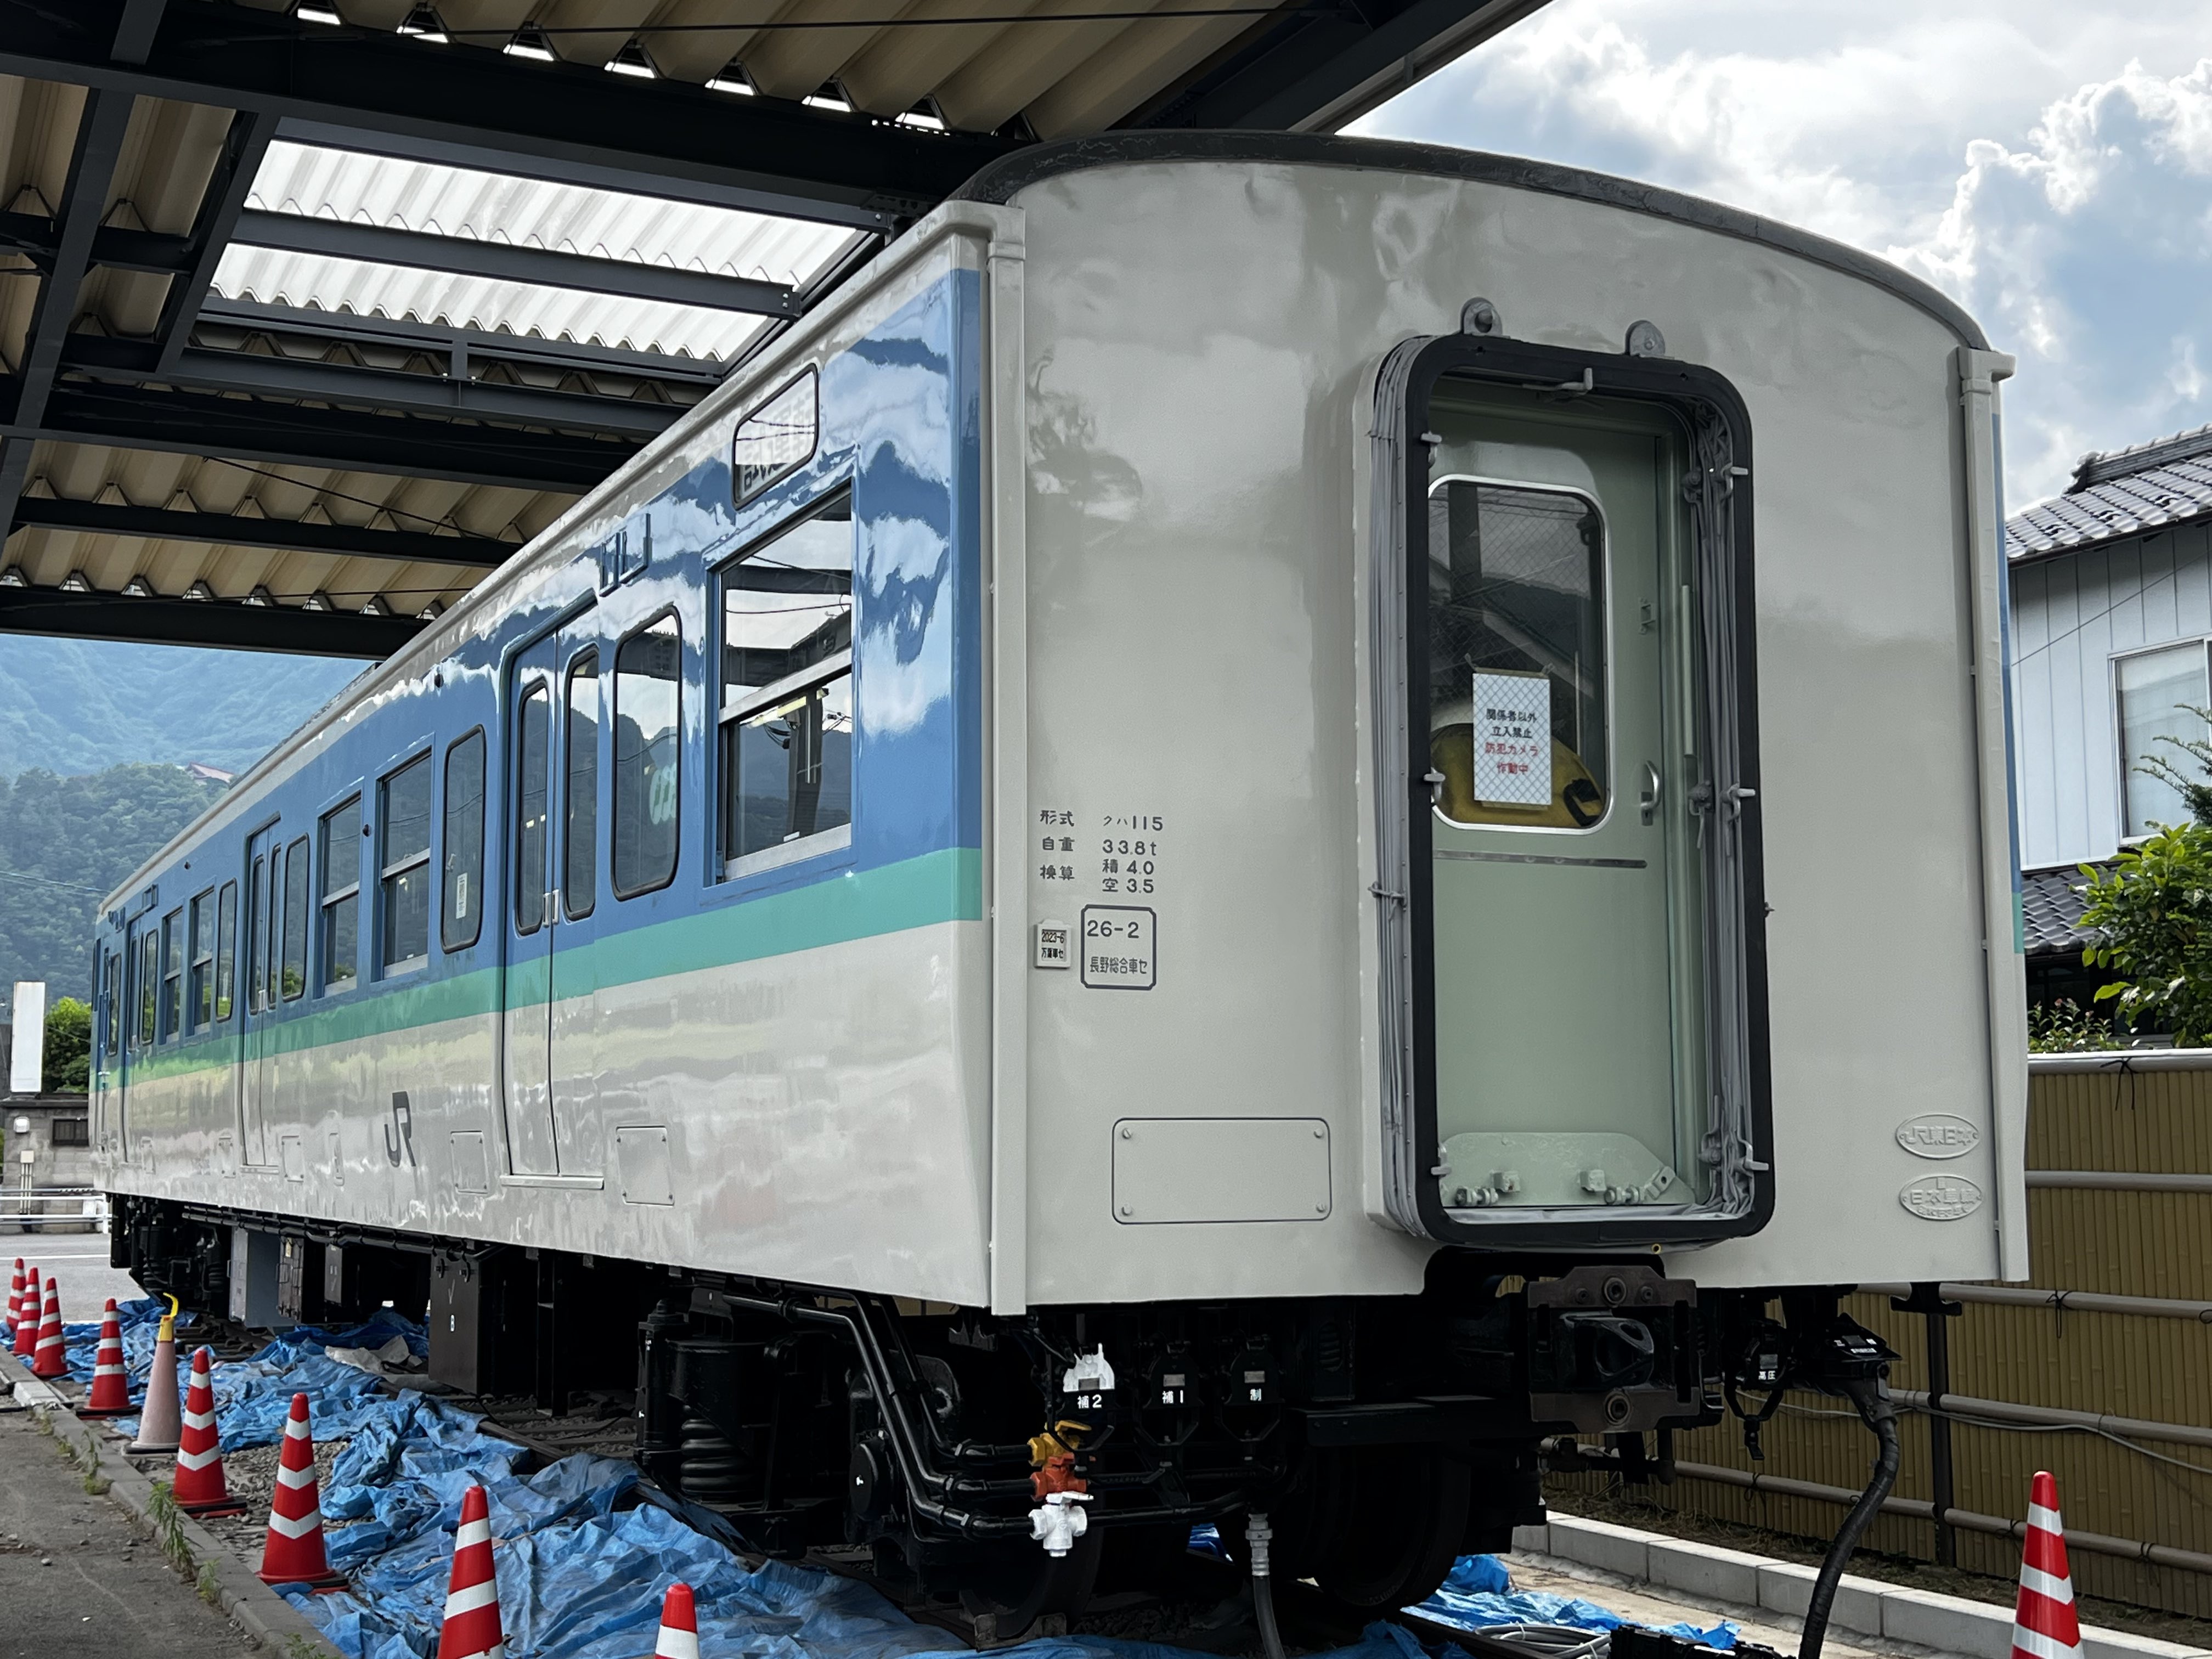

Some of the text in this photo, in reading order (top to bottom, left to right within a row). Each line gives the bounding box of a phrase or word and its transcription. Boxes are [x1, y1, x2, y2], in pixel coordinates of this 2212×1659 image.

[1486, 708, 1538, 723] 関係者以外
[1491, 726, 1532, 739] 立入禁止
[1485, 742, 1538, 757] 防犯カメラ
[1497, 763, 1529, 775] 作動中
[1039, 809, 1164, 832] 形式 クハ115
[1041, 836, 1075, 852] 自重
[1039, 864, 1075, 881] 換算
[1102, 858, 1119, 874] 積
[1102, 877, 1155, 894] 空 3.5
[1086, 919, 1140, 939] 26-2
[1089, 956, 1148, 974] 長野総合車セ
[384, 1091, 416, 1167] JR
